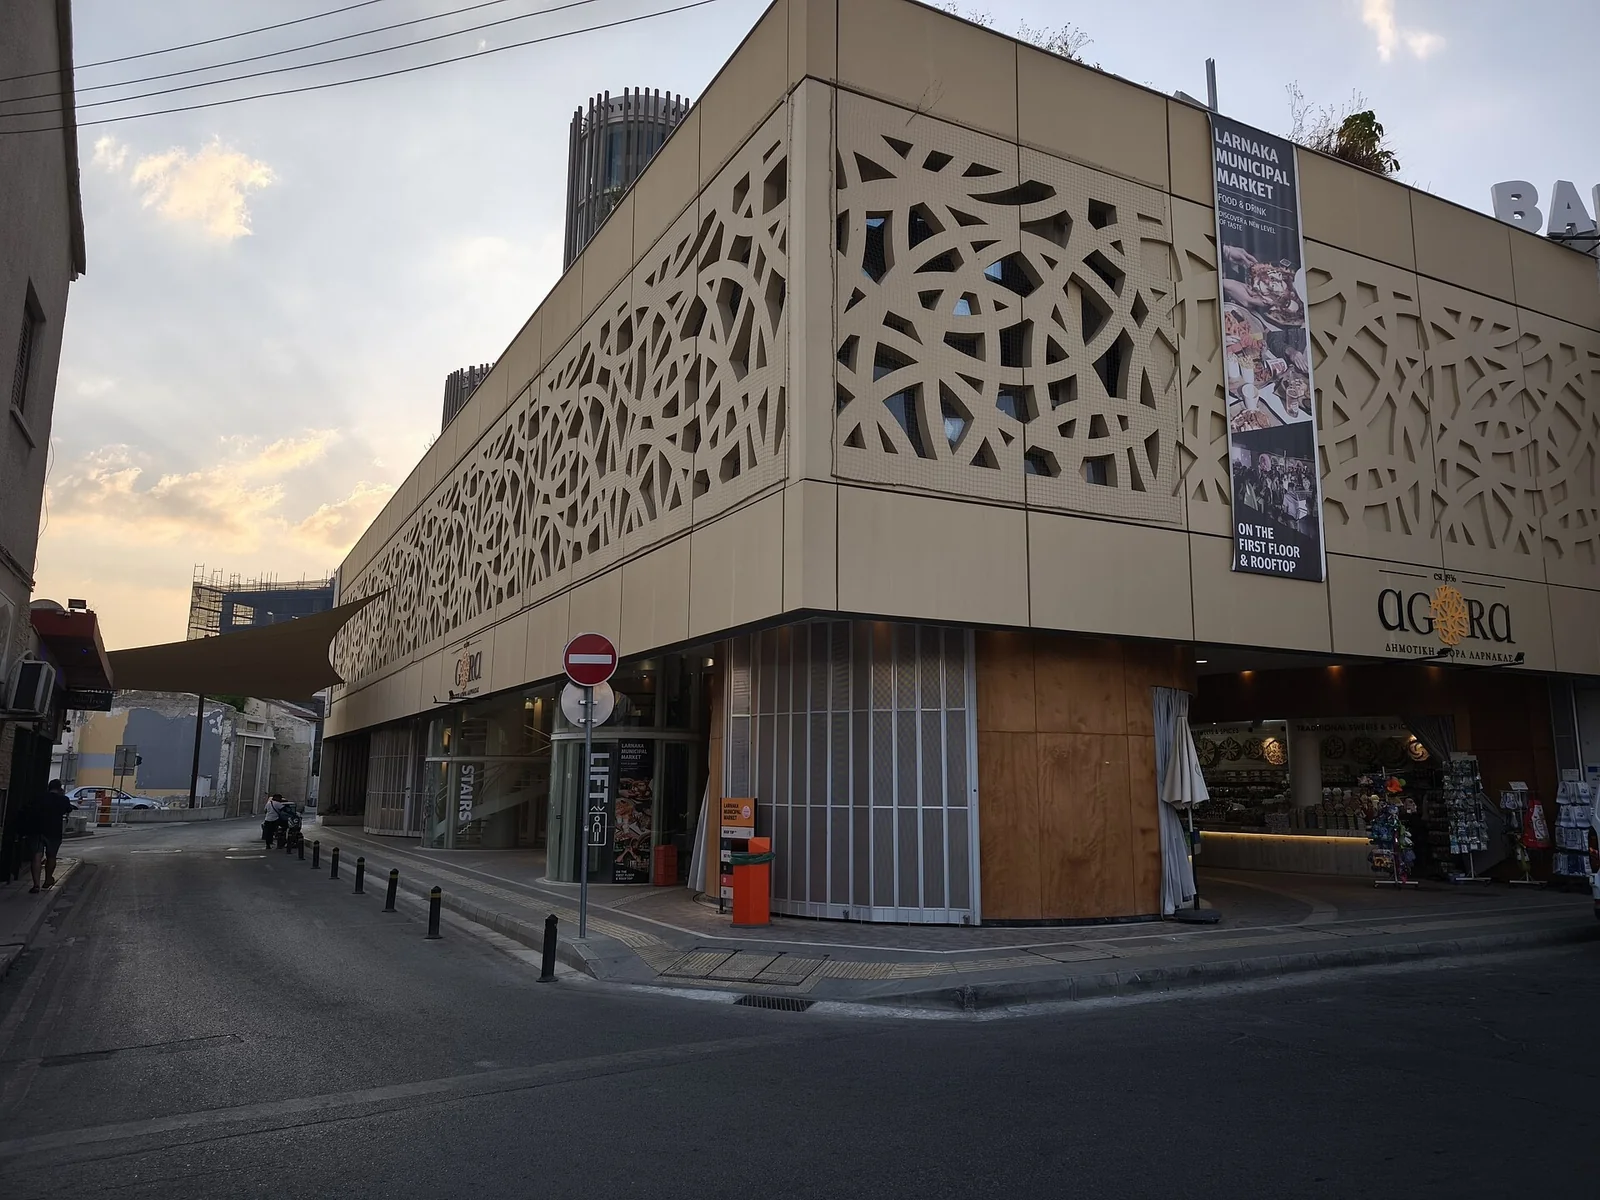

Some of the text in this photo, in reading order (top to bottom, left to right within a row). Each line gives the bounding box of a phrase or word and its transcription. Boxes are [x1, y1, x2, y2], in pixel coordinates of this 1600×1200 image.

[1214, 127, 1279, 164] LARNAKA
[1216, 147, 1290, 187] MUNICIPAL
[1217, 167, 1274, 199] MARKET
[1218, 193, 1267, 216] FOOD & DRINK
[1490, 180, 1600, 237] BA
[1219, 210, 1244, 224] DISCOVER
[1248, 220, 1260, 230] NEW
[1260, 224, 1276, 235] LEVEL
[1219, 218, 1243, 232] OF TASTE
[1238, 522, 1274, 540] ON THE
[1239, 538, 1300, 558] FIRST FLOOR
[1240, 554, 1296, 573] & ROOFTOP
[1385, 642, 1435, 656] ΔΗΜΟΤΙΚΗ
[1469, 651, 1513, 663] ΛΑΡΝΑΚΑΣ
[590, 752, 610, 803] LIFT
[459, 765, 475, 821] STAIRS
